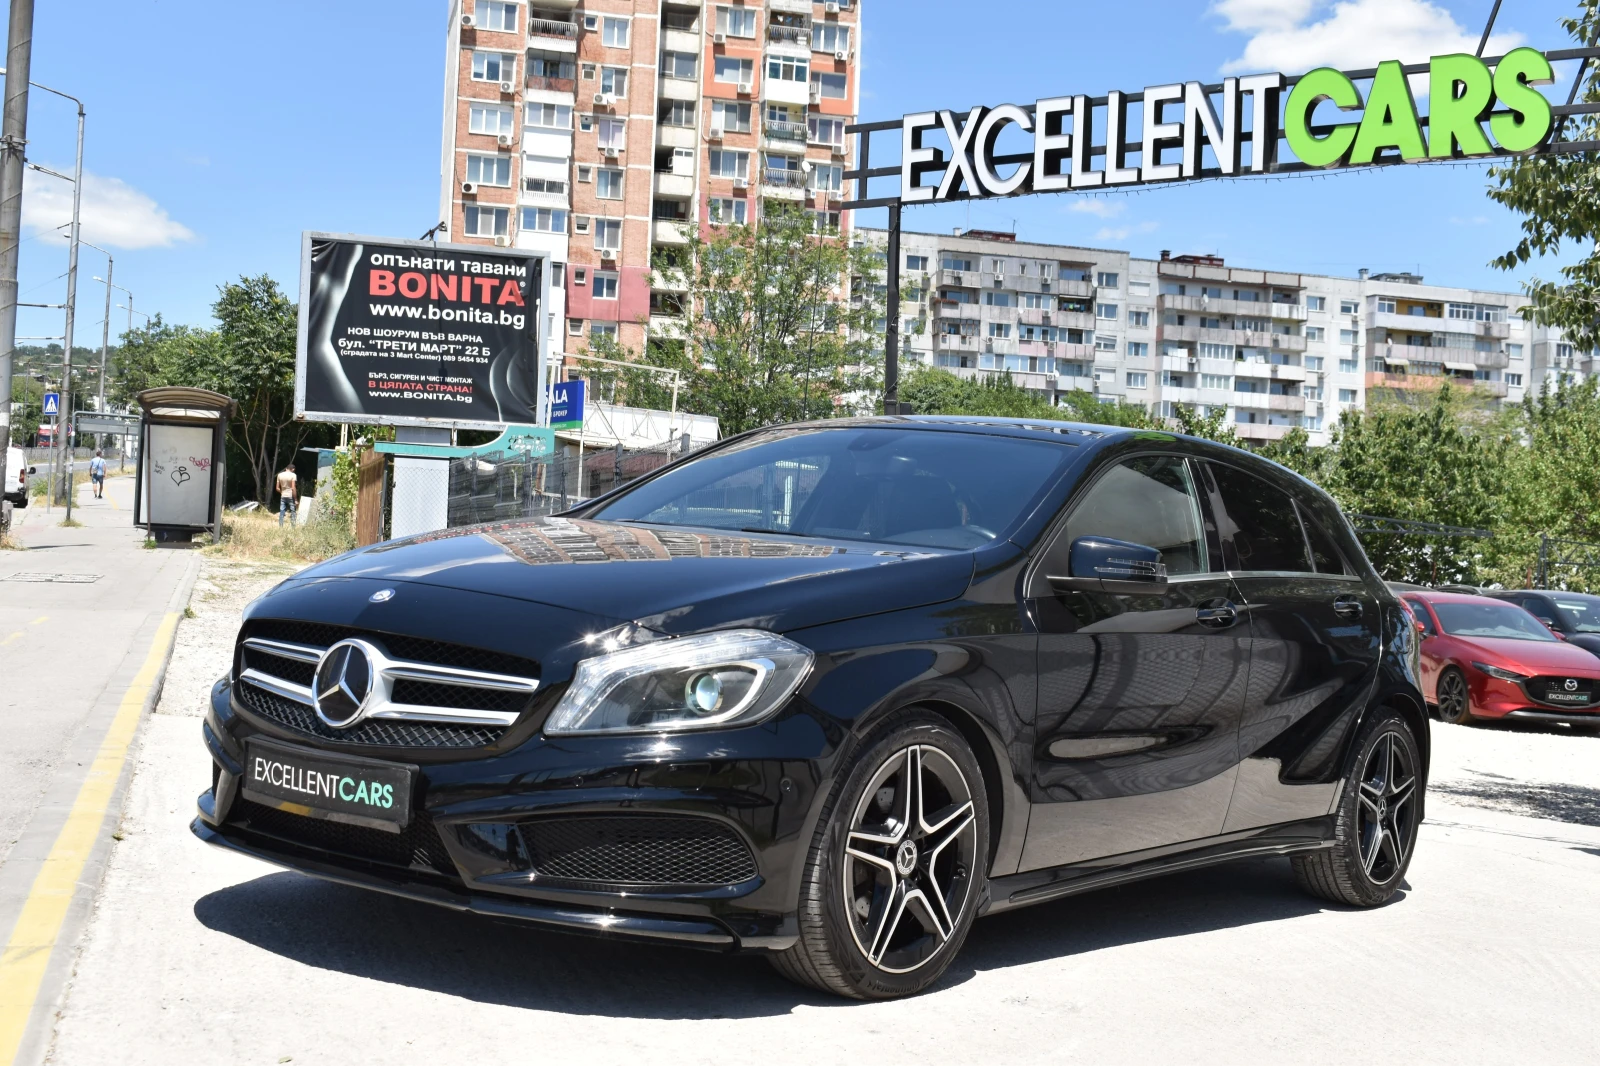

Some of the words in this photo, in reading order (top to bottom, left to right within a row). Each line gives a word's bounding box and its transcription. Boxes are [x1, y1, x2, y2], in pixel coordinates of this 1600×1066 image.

[370, 253, 455, 271] опънати
[461, 260, 527, 277] тавани
[370, 303, 525, 330] www.bonita.bg
[347, 327, 371, 336] НОВ
[373, 328, 420, 339] ШОУРУМ
[421, 331, 445, 341] ВЪВ
[447, 333, 483, 343] ВАРНА
[338, 338, 365, 350] бул.
[465, 345, 479, 356] 22
[482, 347, 491, 356] Б
[368, 380, 376, 388] В
[379, 381, 424, 391] ЦЯЛАТА
[426, 383, 473, 393] СТРАНА!
[368, 390, 473, 403] www.BONITA.bg
